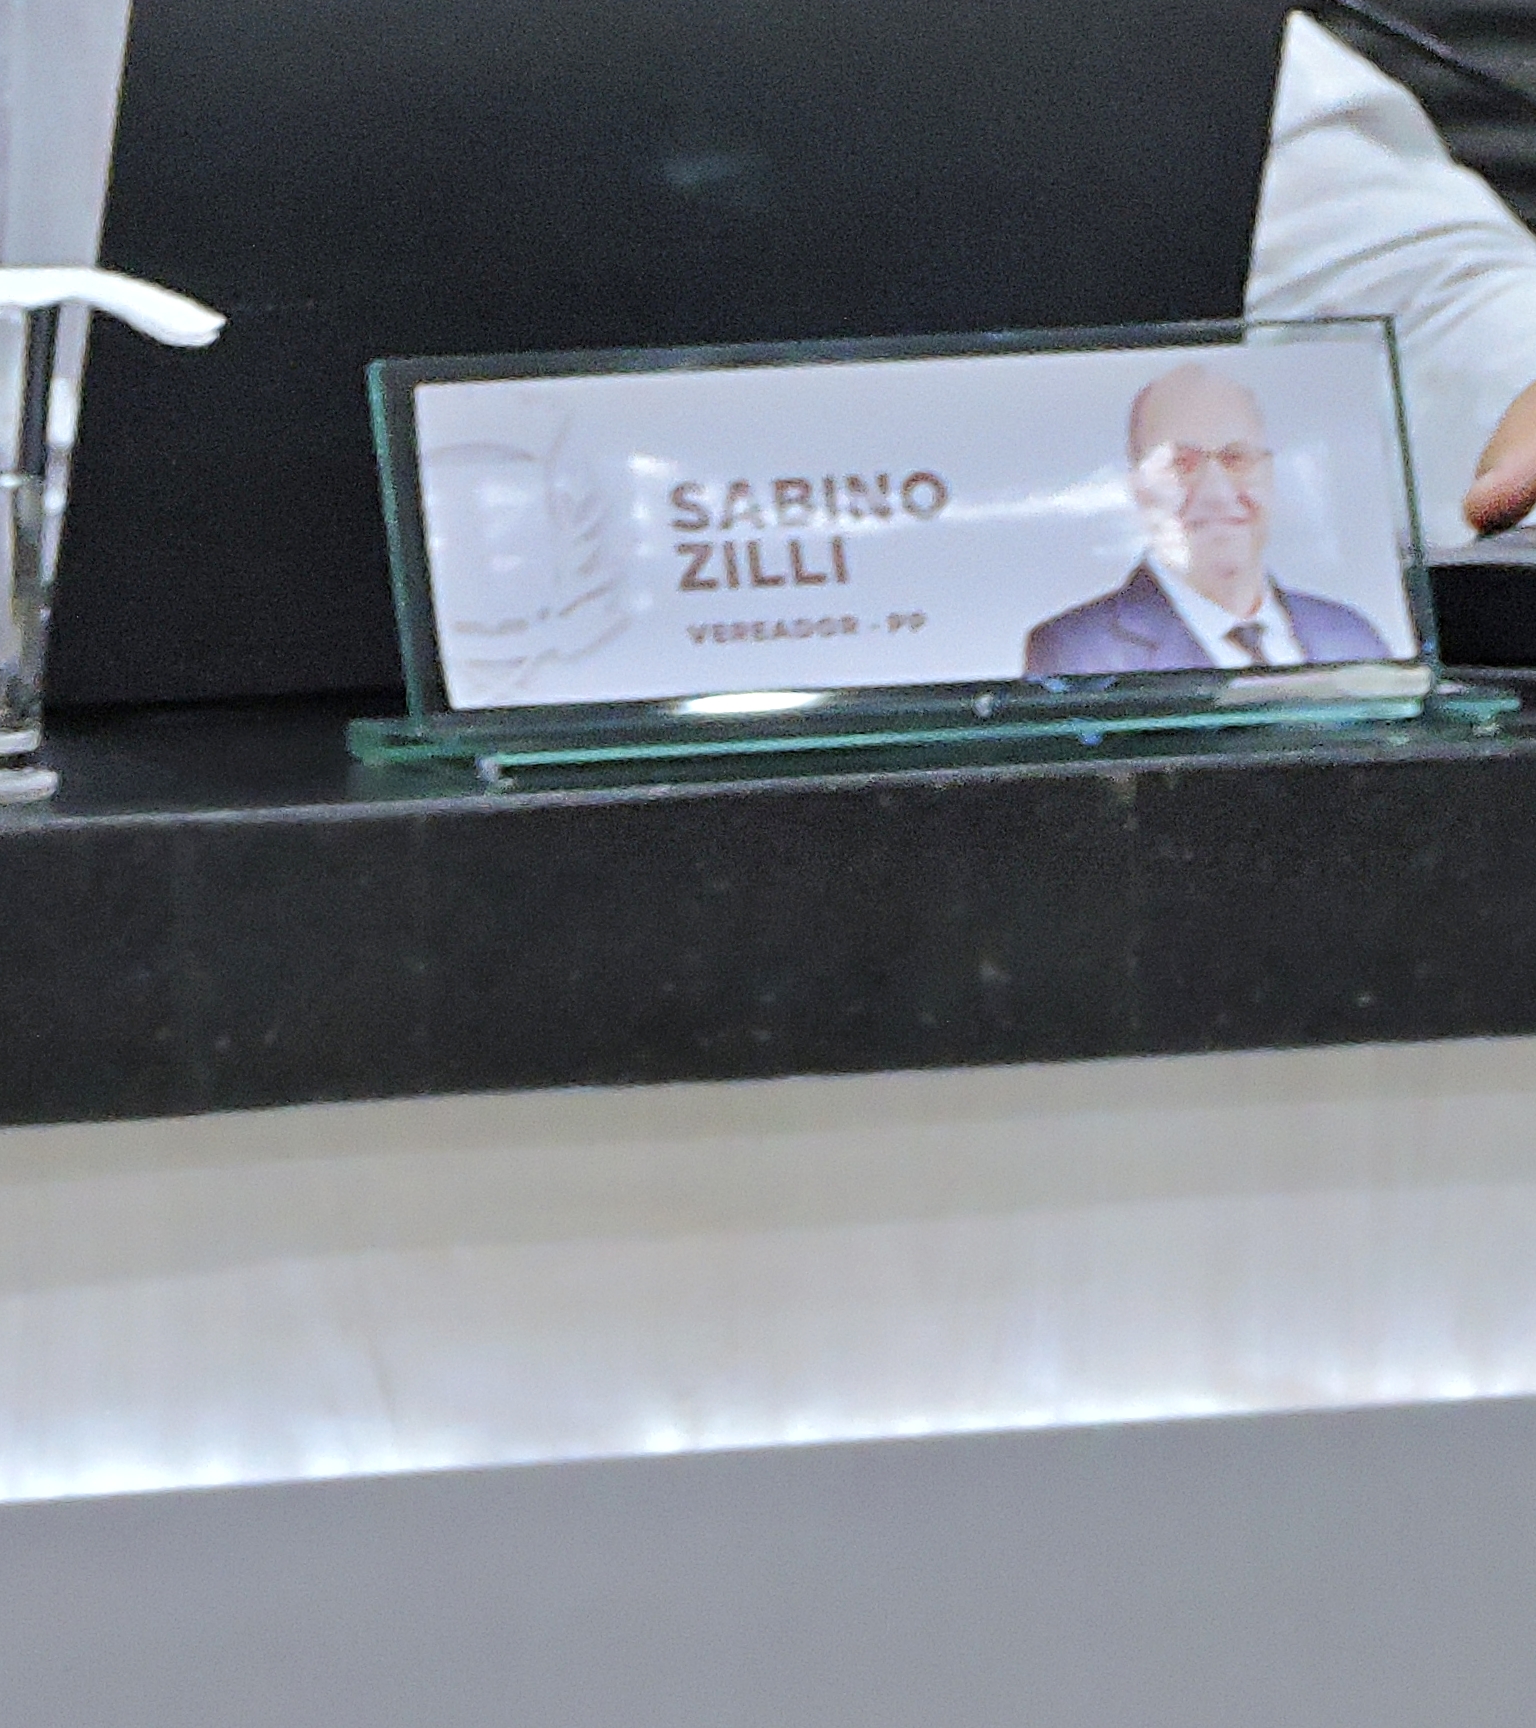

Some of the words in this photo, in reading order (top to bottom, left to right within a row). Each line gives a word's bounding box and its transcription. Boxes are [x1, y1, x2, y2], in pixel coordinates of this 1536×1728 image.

[670, 470, 949, 531] SABINO
[675, 535, 849, 592] ZILLI
[685, 614, 860, 645] VEREADOR
